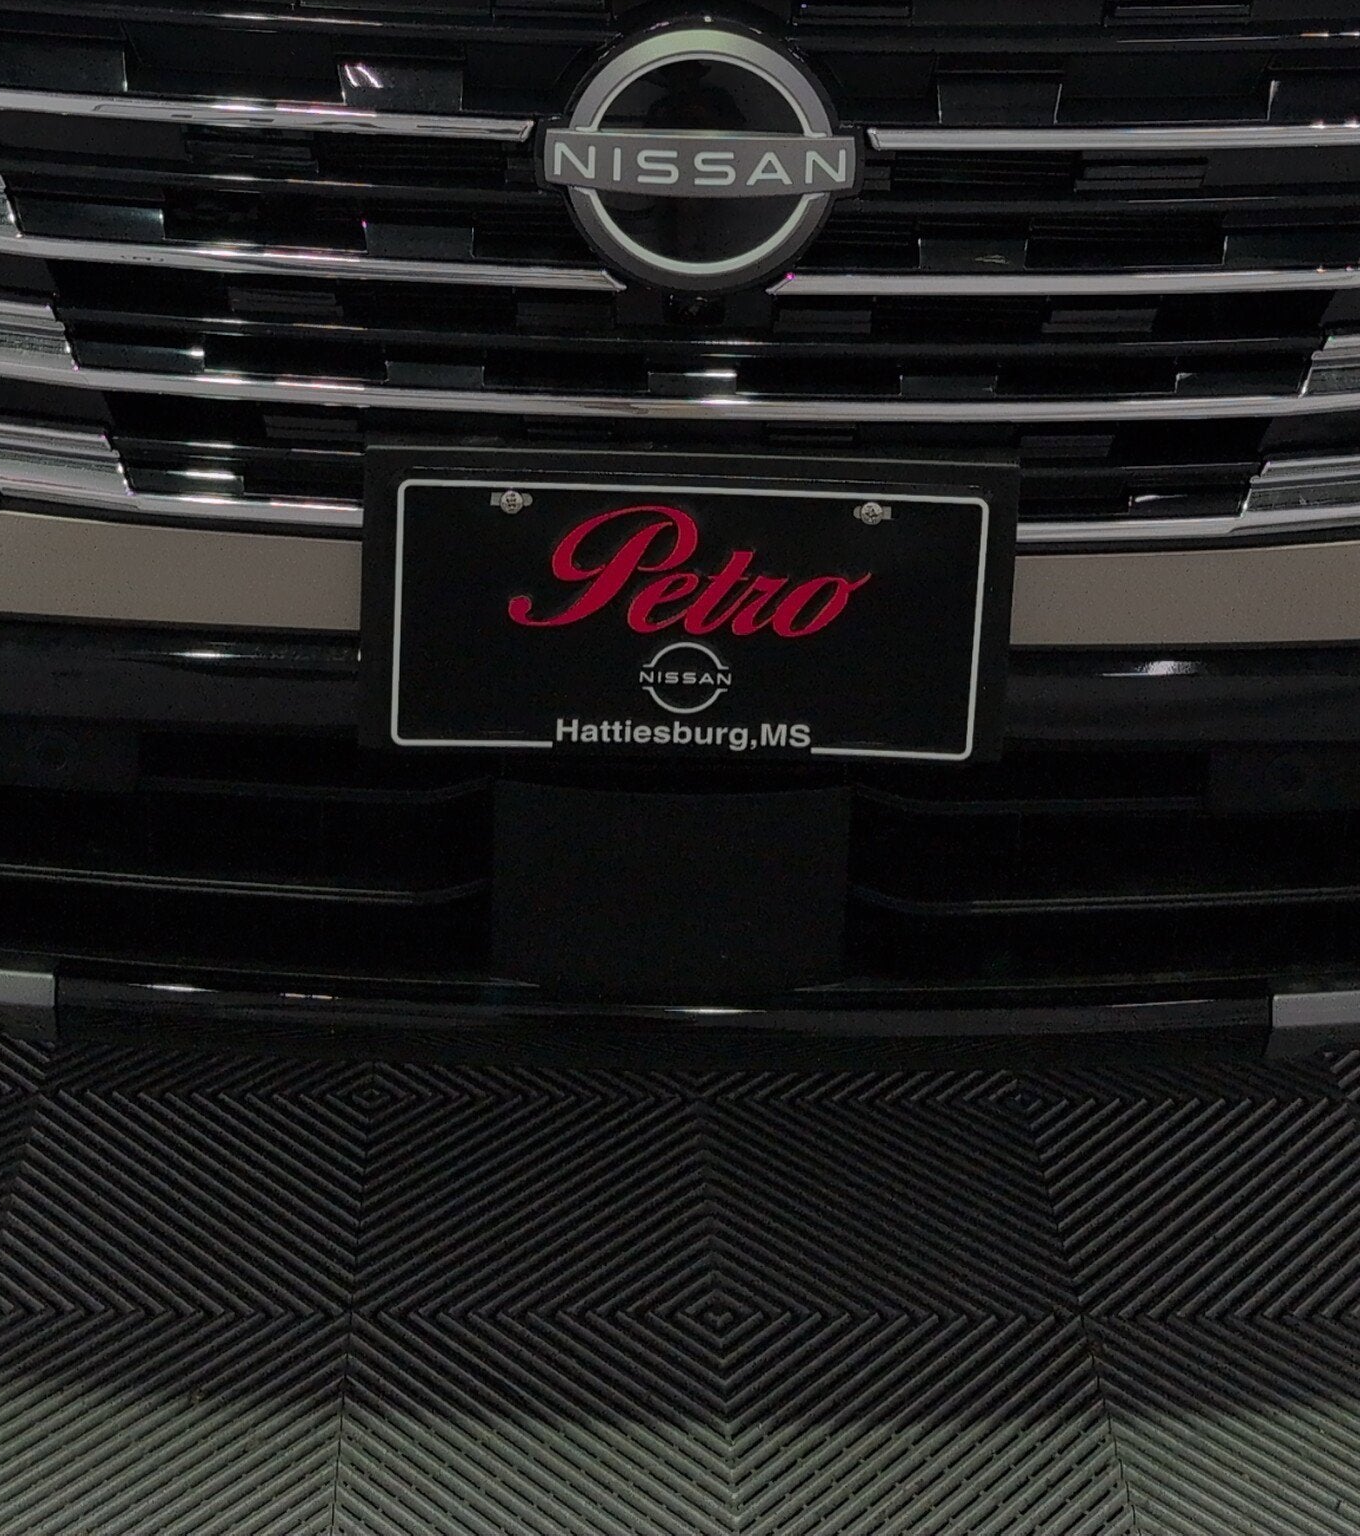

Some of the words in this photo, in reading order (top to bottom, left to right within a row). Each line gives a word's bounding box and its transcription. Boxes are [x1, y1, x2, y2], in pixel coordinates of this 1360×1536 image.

[552, 141, 847, 187] NISSAN
[507, 504, 872, 638] Petro
[639, 670, 732, 686] NISSAN
